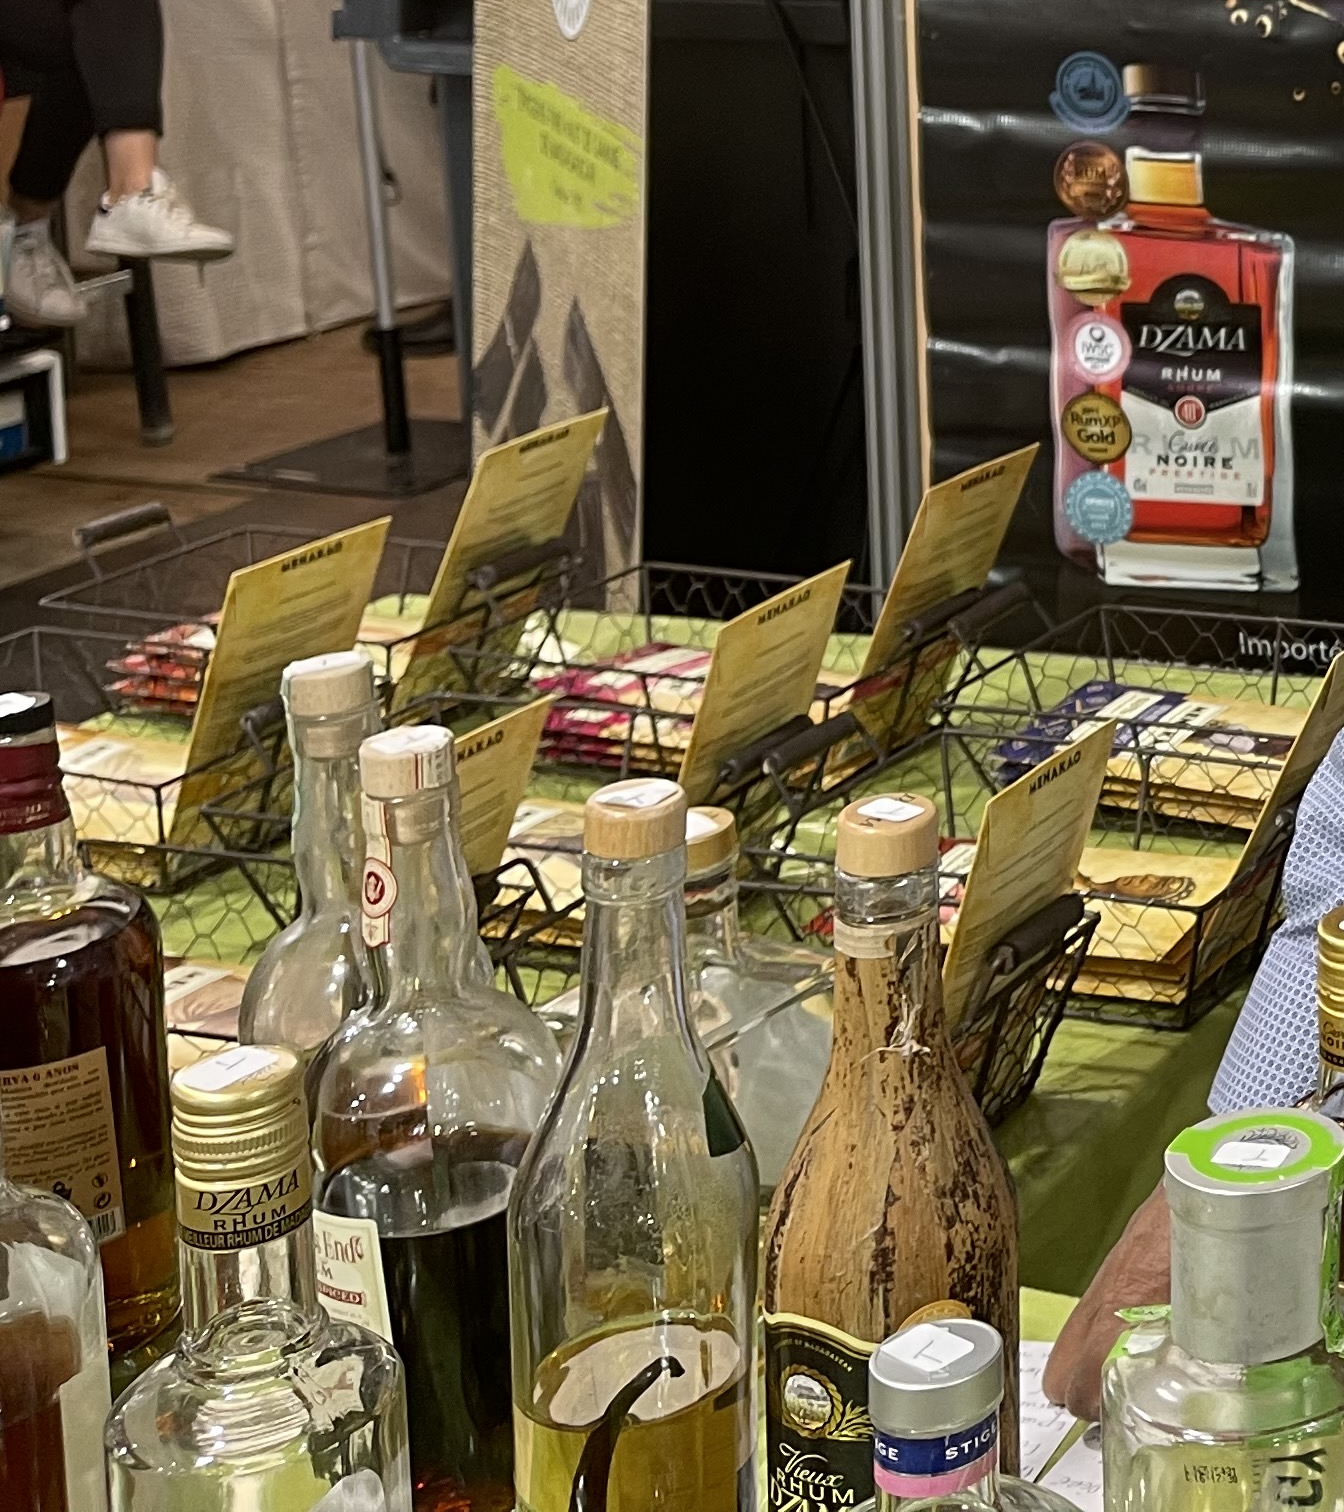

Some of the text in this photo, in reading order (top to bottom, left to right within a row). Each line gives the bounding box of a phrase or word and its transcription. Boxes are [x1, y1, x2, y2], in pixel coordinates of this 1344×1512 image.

[1138, 324, 1246, 357] DZAMA
[1160, 365, 1223, 383] RHUM
[1077, 429, 1116, 445] Gold
[1156, 454, 1234, 470] NOIRE
[456, 729, 505, 762] NAKAO
[194, 1168, 301, 1216] DZAMA
[213, 1203, 288, 1232] RHUM
[226, 1229, 263, 1248] RHUM
[264, 1225, 280, 1240] DE
[874, 1437, 899, 1461] IGE
[778, 1442, 844, 1487] Vieux
[776, 1467, 855, 1504] RHUM
